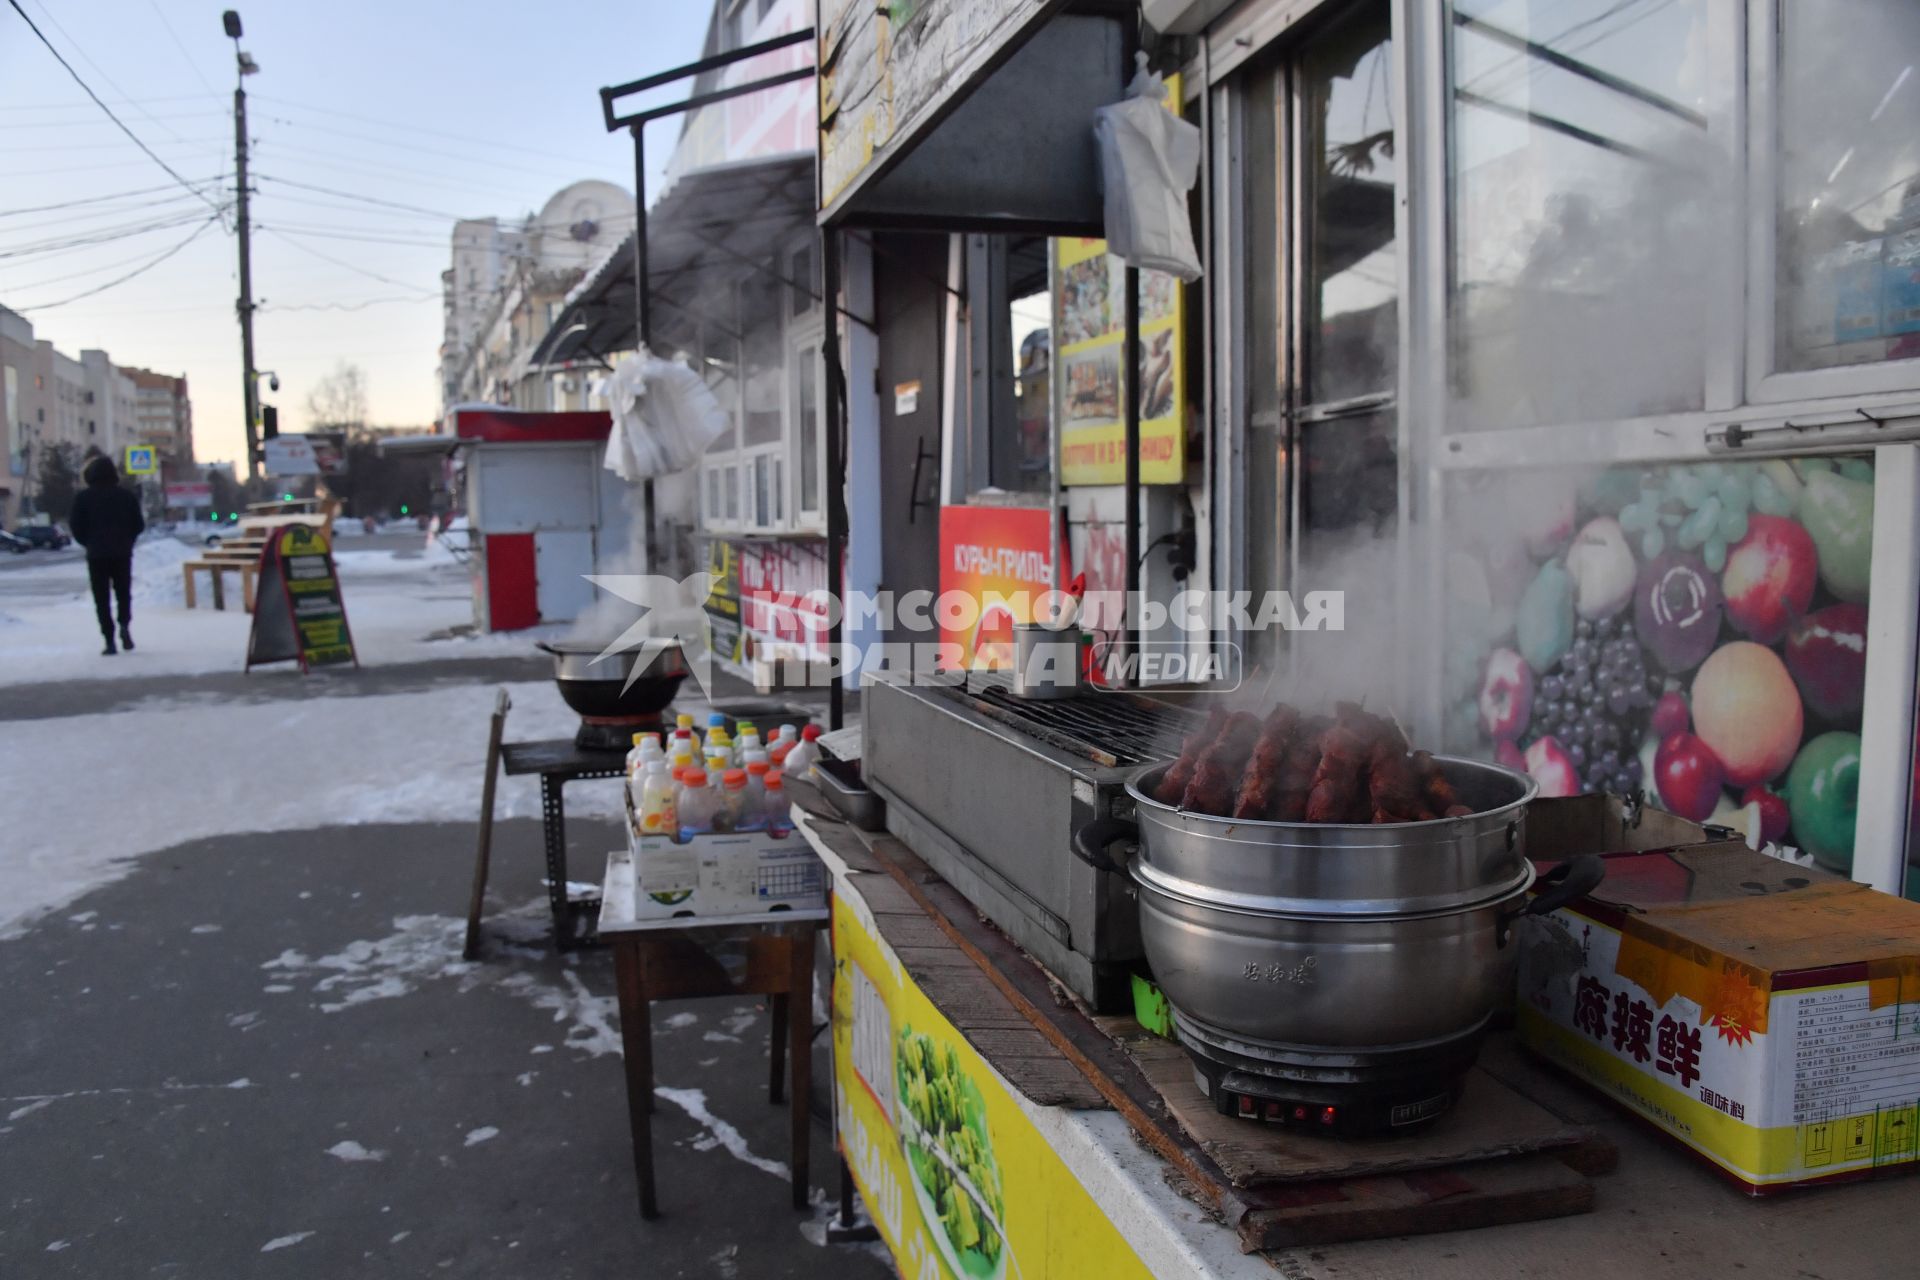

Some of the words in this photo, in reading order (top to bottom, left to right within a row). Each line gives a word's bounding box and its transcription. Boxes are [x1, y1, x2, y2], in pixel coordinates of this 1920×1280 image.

[954, 543, 1052, 585] КУРЫ-ГРИЛЬ
[1574, 976, 1702, 1088] 麻辣鲜
[1700, 1086, 1745, 1121] 调味料
